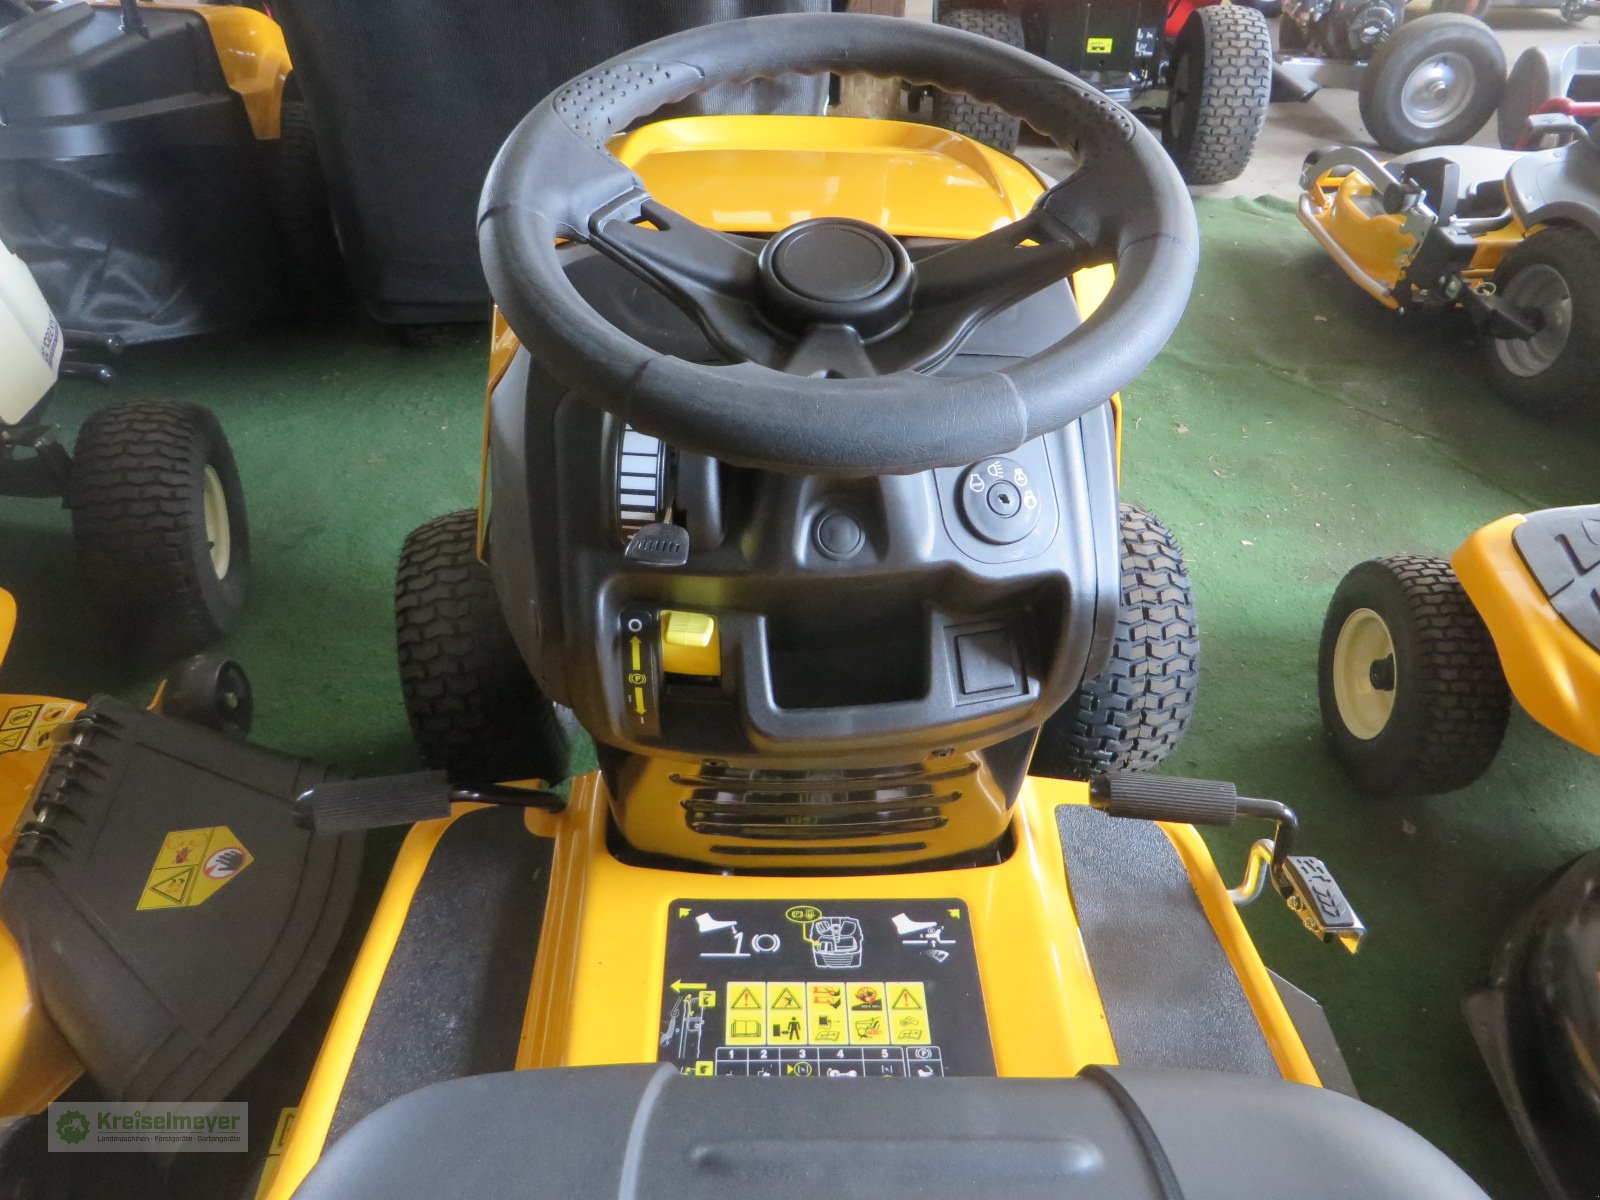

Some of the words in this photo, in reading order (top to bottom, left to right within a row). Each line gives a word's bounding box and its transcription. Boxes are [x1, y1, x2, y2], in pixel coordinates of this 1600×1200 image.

[729, 1050, 735, 1059] 1
[760, 1050, 768, 1059] 2
[799, 1050, 806, 1059] 3
[836, 1050, 844, 1059] 4
[881, 1049, 889, 1058] 5
